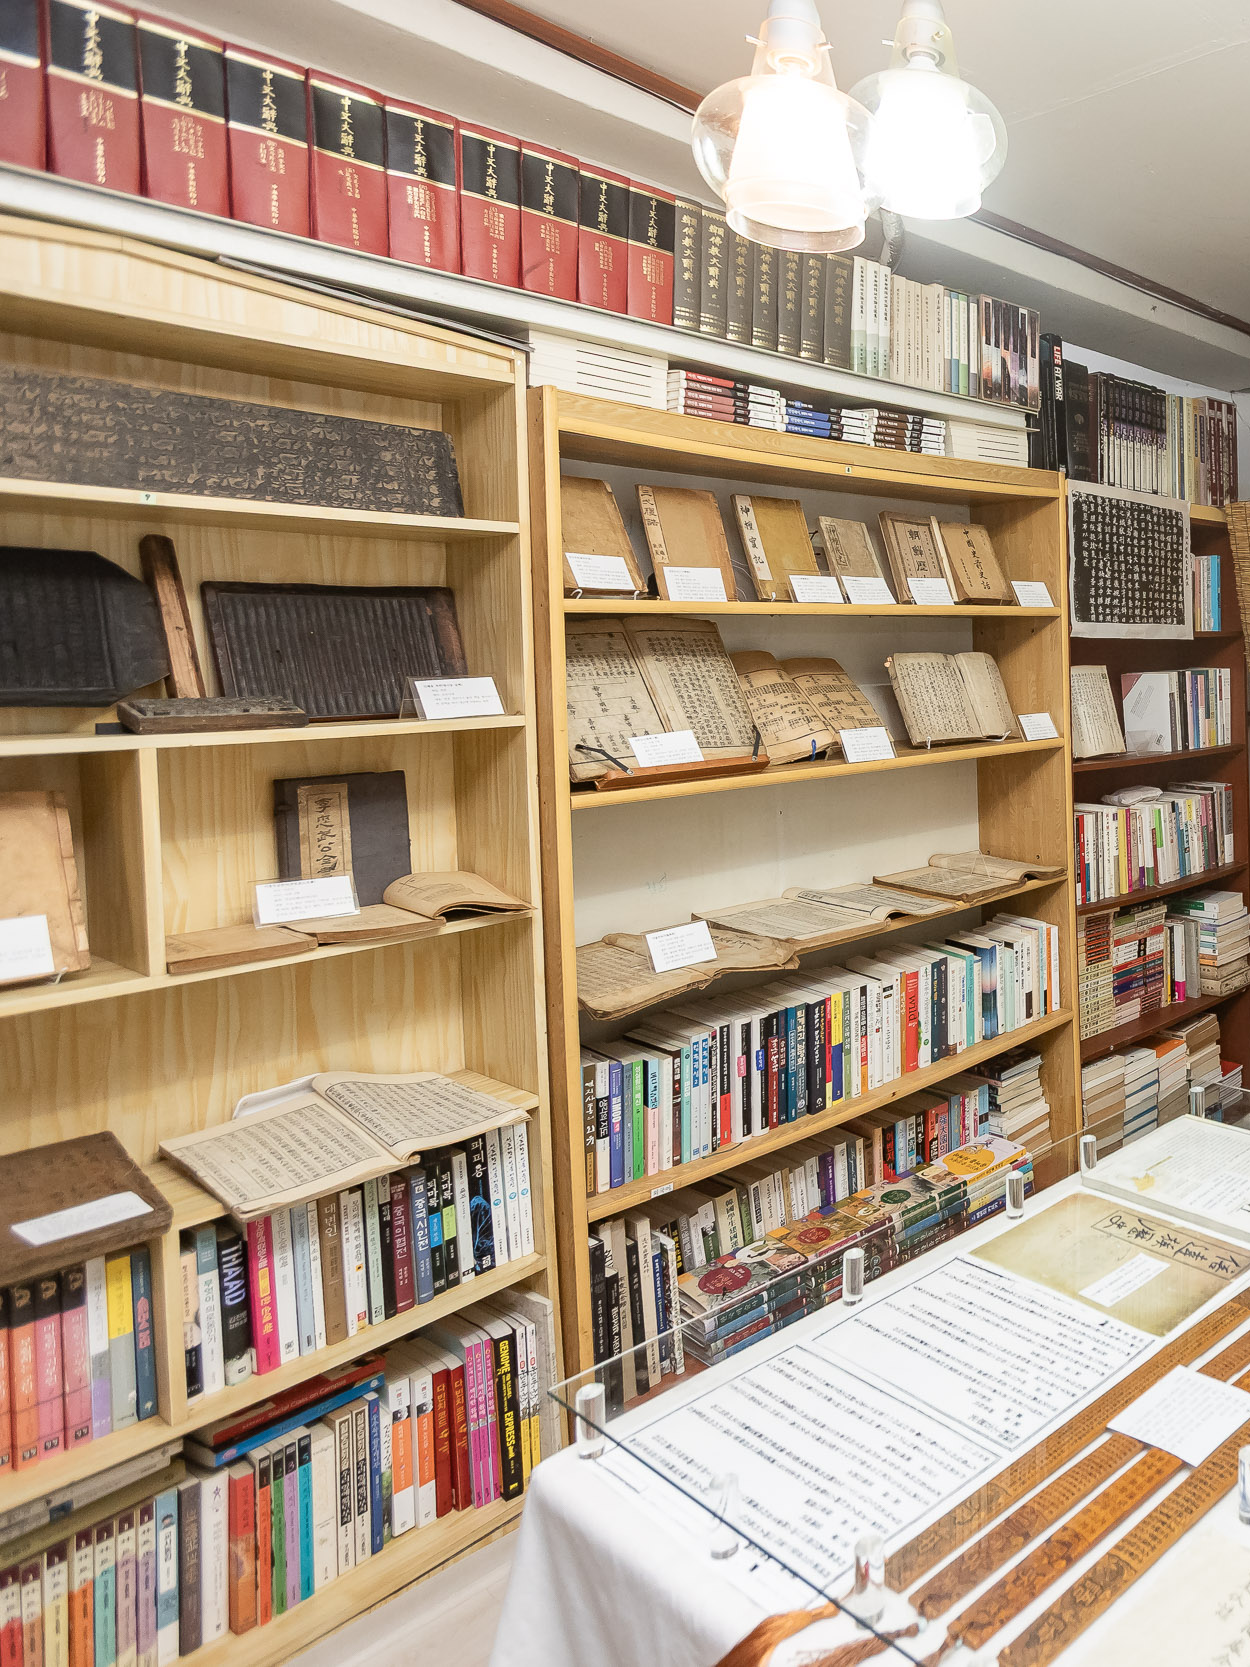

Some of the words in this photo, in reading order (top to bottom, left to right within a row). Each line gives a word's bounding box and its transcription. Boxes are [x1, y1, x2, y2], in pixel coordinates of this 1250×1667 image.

[174, 40, 193, 108] 中文大辭典
[261, 70, 278, 132] 中文大辭典
[340, 97, 355, 158] 中文大辭典
[413, 119, 427, 177] 中文大辭典
[486, 144, 498, 200] 中文大辭典
[543, 161, 555, 214] 中文大辭典
[598, 182, 609, 232] 中文大辭典
[1053, 345, 1062, 365] LIFE
[1054, 366, 1063, 377] AT
[1055, 378, 1063, 401] WAR
[907, 529, 928, 578] 朝鮮歷
[471, 1138, 486, 1178] 파피용
[221, 1242, 247, 1307] THAAD
[499, 1340, 511, 1372] GENOME
[504, 1411, 515, 1449] EXPRESS
